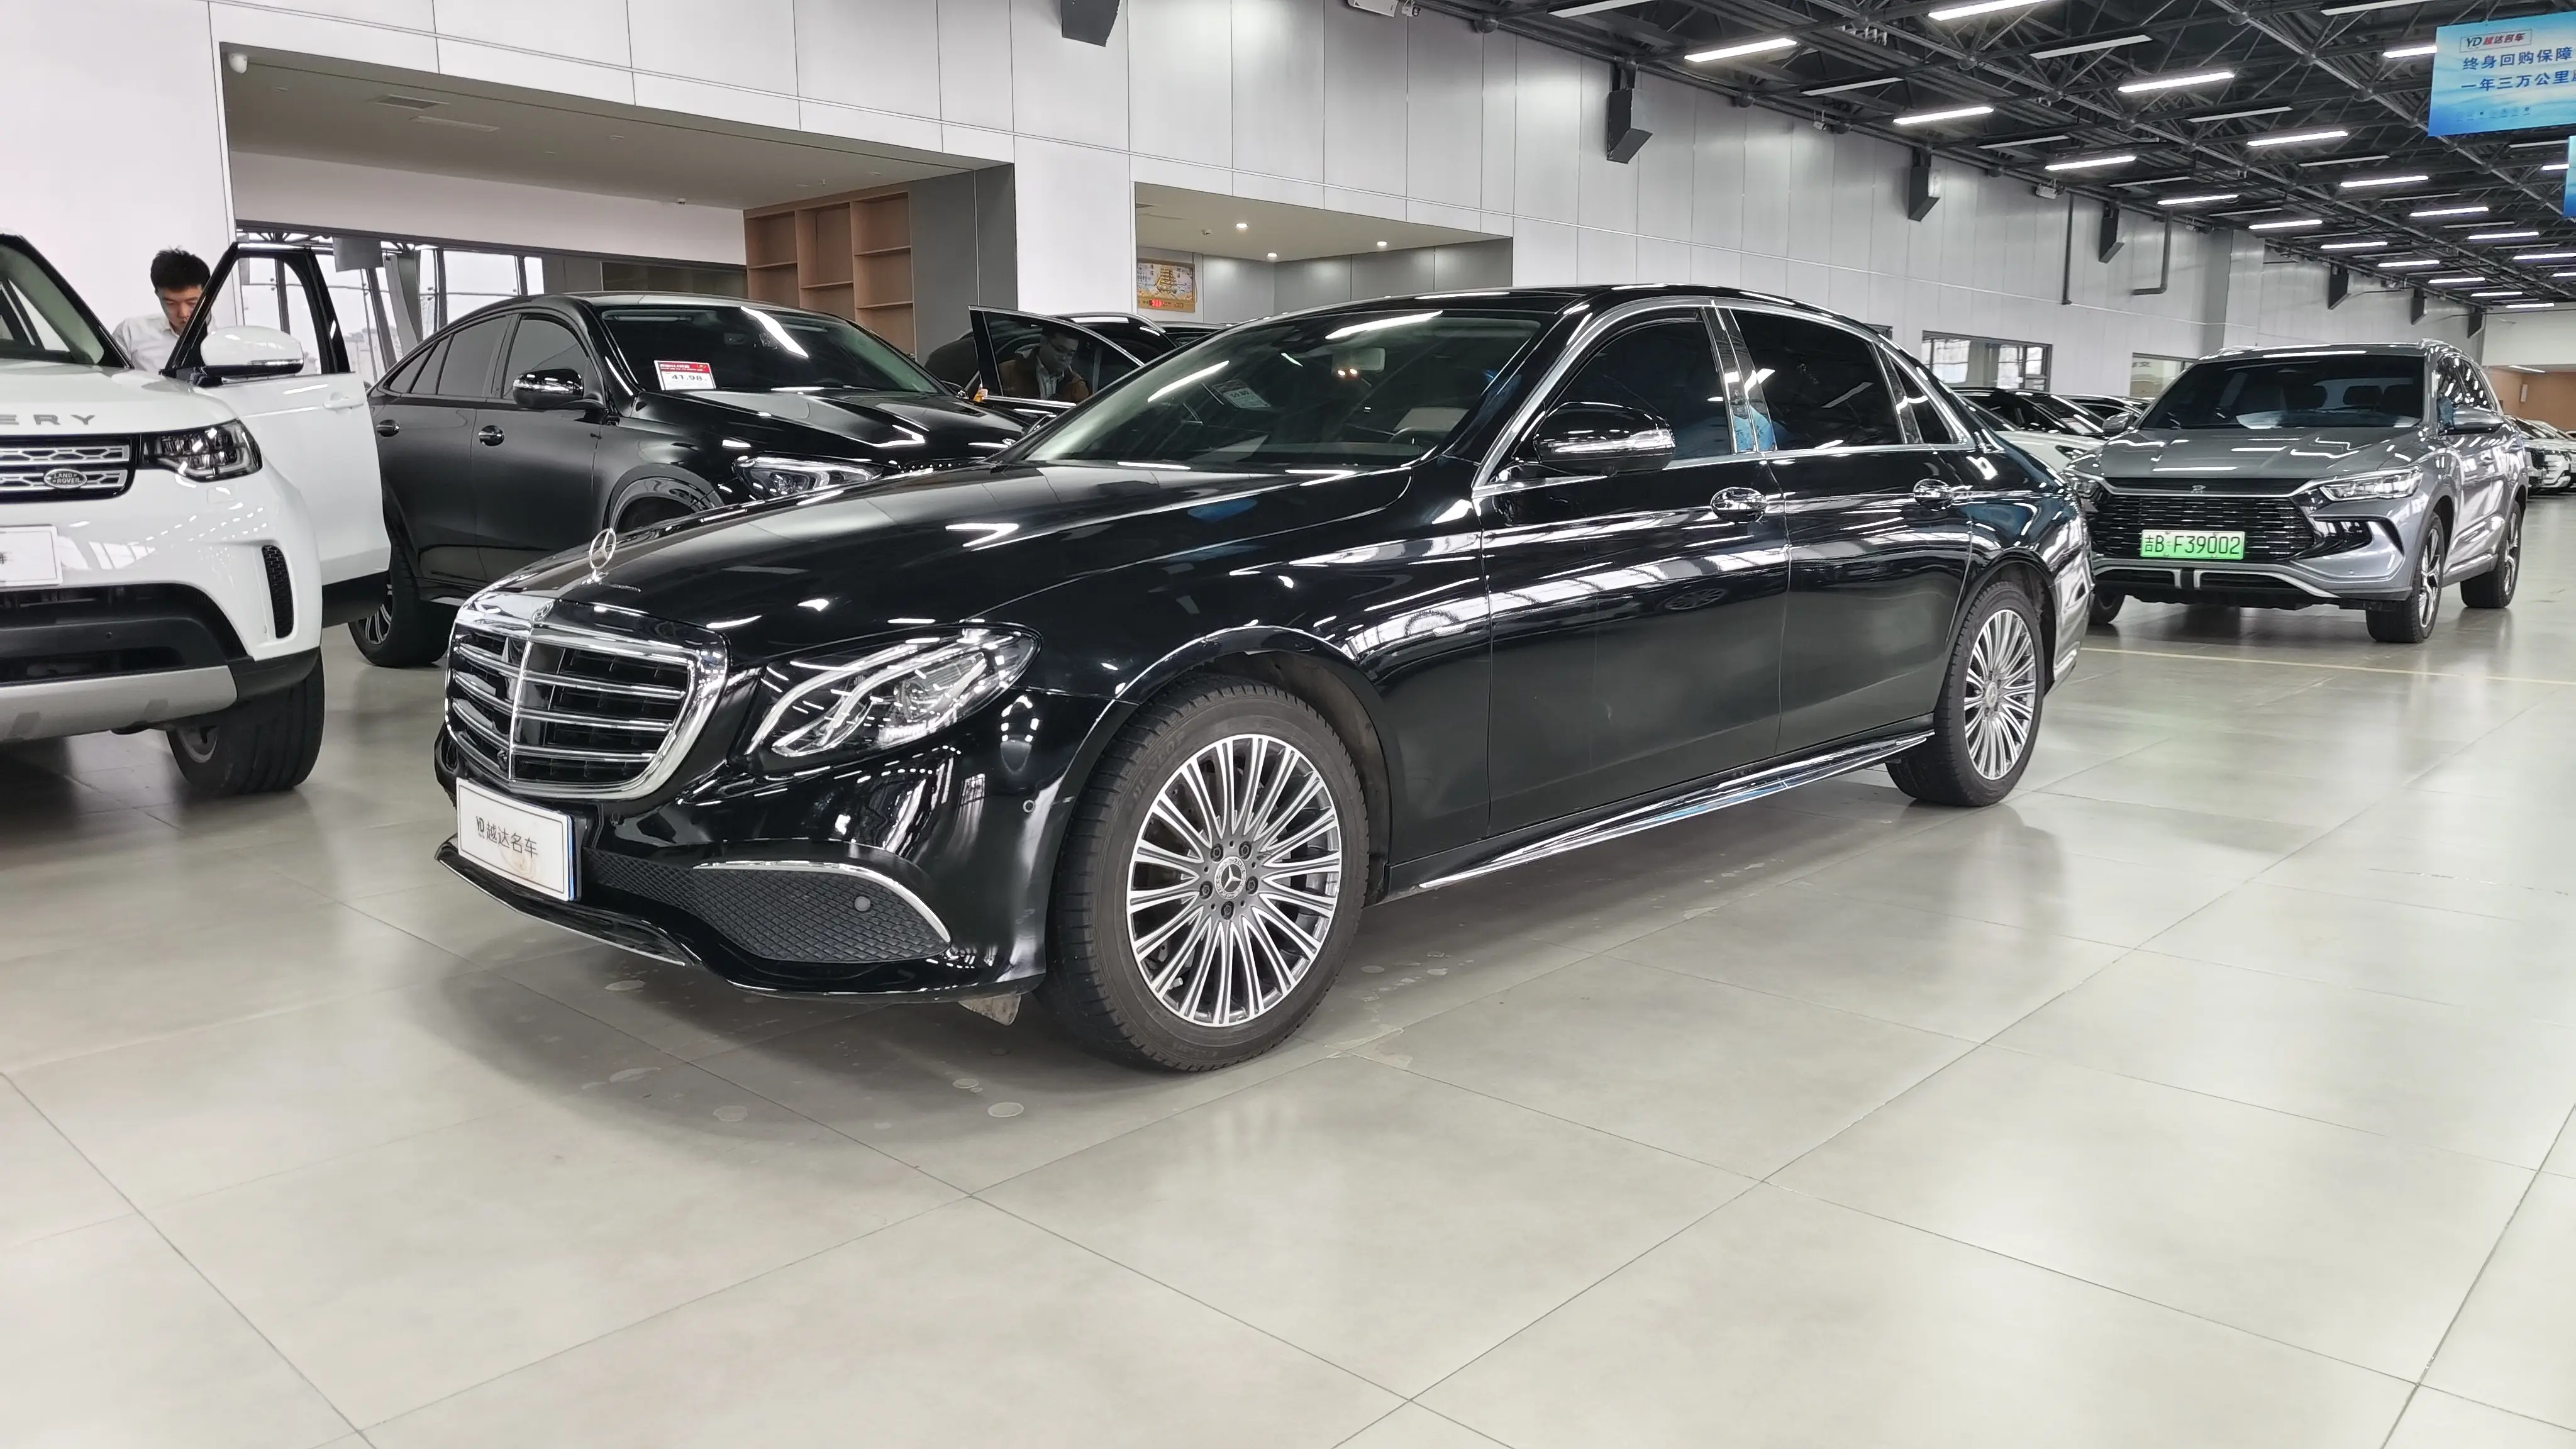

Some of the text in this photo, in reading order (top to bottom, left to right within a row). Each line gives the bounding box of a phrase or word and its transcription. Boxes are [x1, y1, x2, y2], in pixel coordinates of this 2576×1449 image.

[2462, 47, 2573, 70] 终身回购保障
[2461, 70, 2576, 91] 一年三万公里
[2174, 535, 2241, 555] F39002
[486, 821, 538, 858] 越达名车
